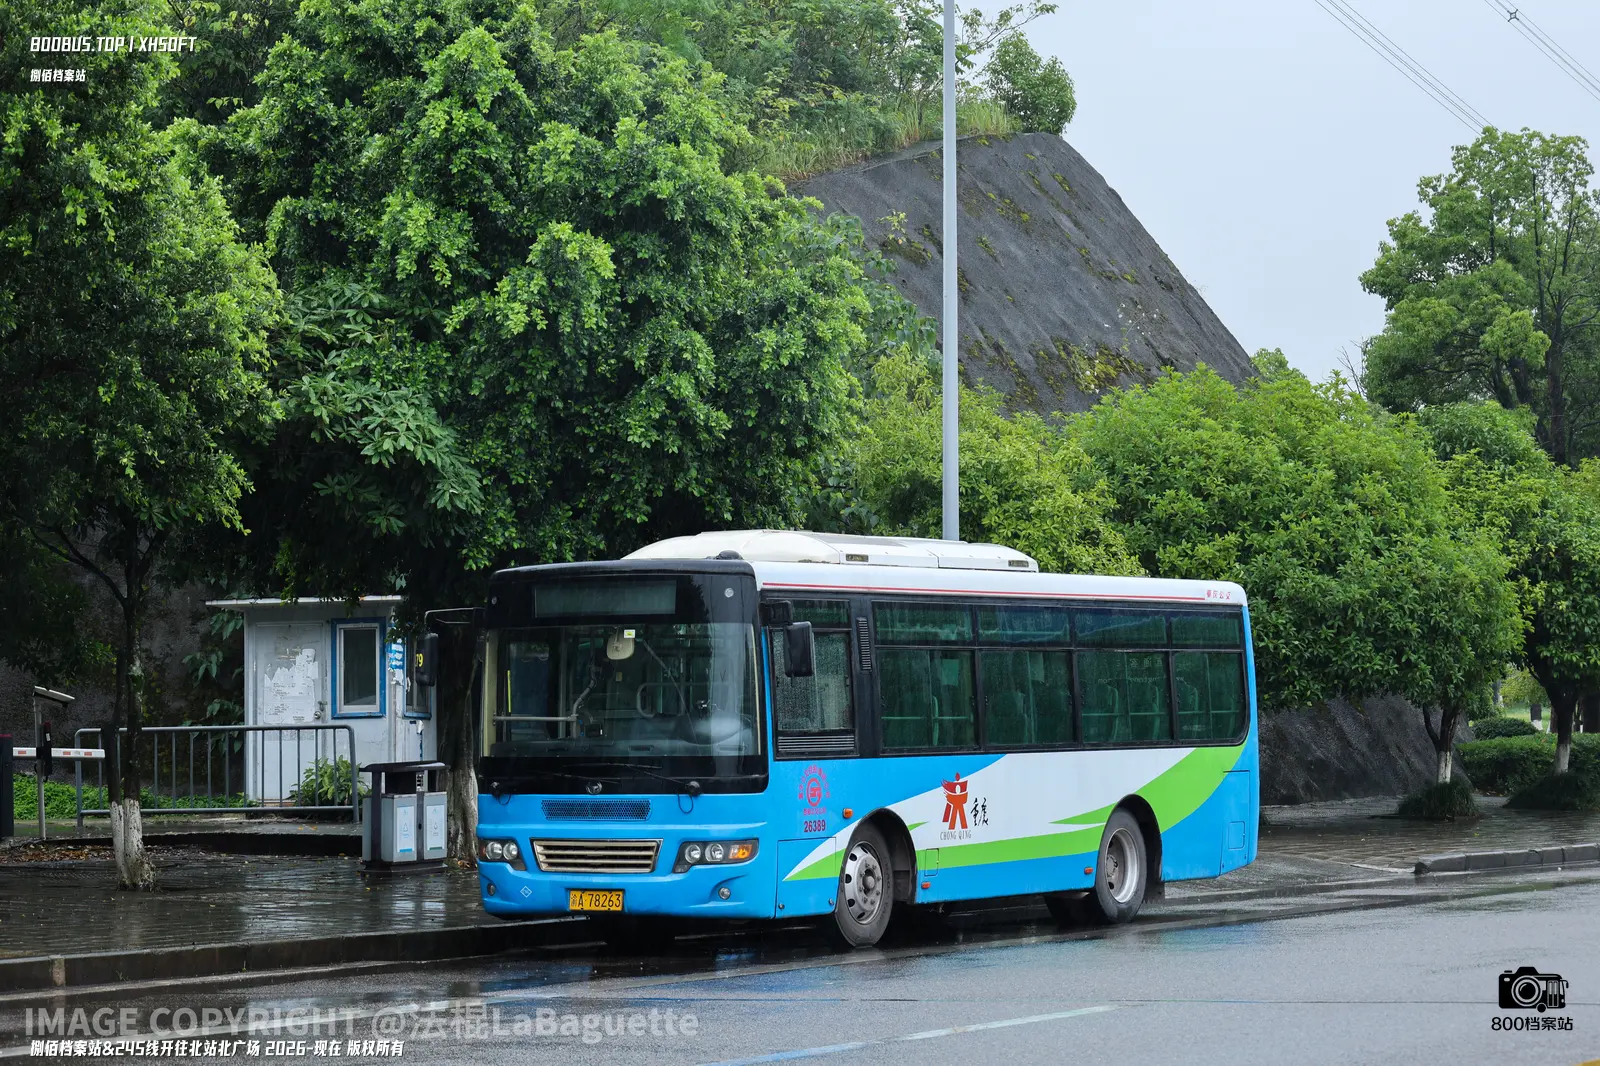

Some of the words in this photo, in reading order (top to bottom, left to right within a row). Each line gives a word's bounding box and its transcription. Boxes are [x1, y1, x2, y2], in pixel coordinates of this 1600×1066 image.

[803, 819, 826, 833] 26389
[939, 831, 957, 841] CHONG
[958, 829, 972, 840] QING
